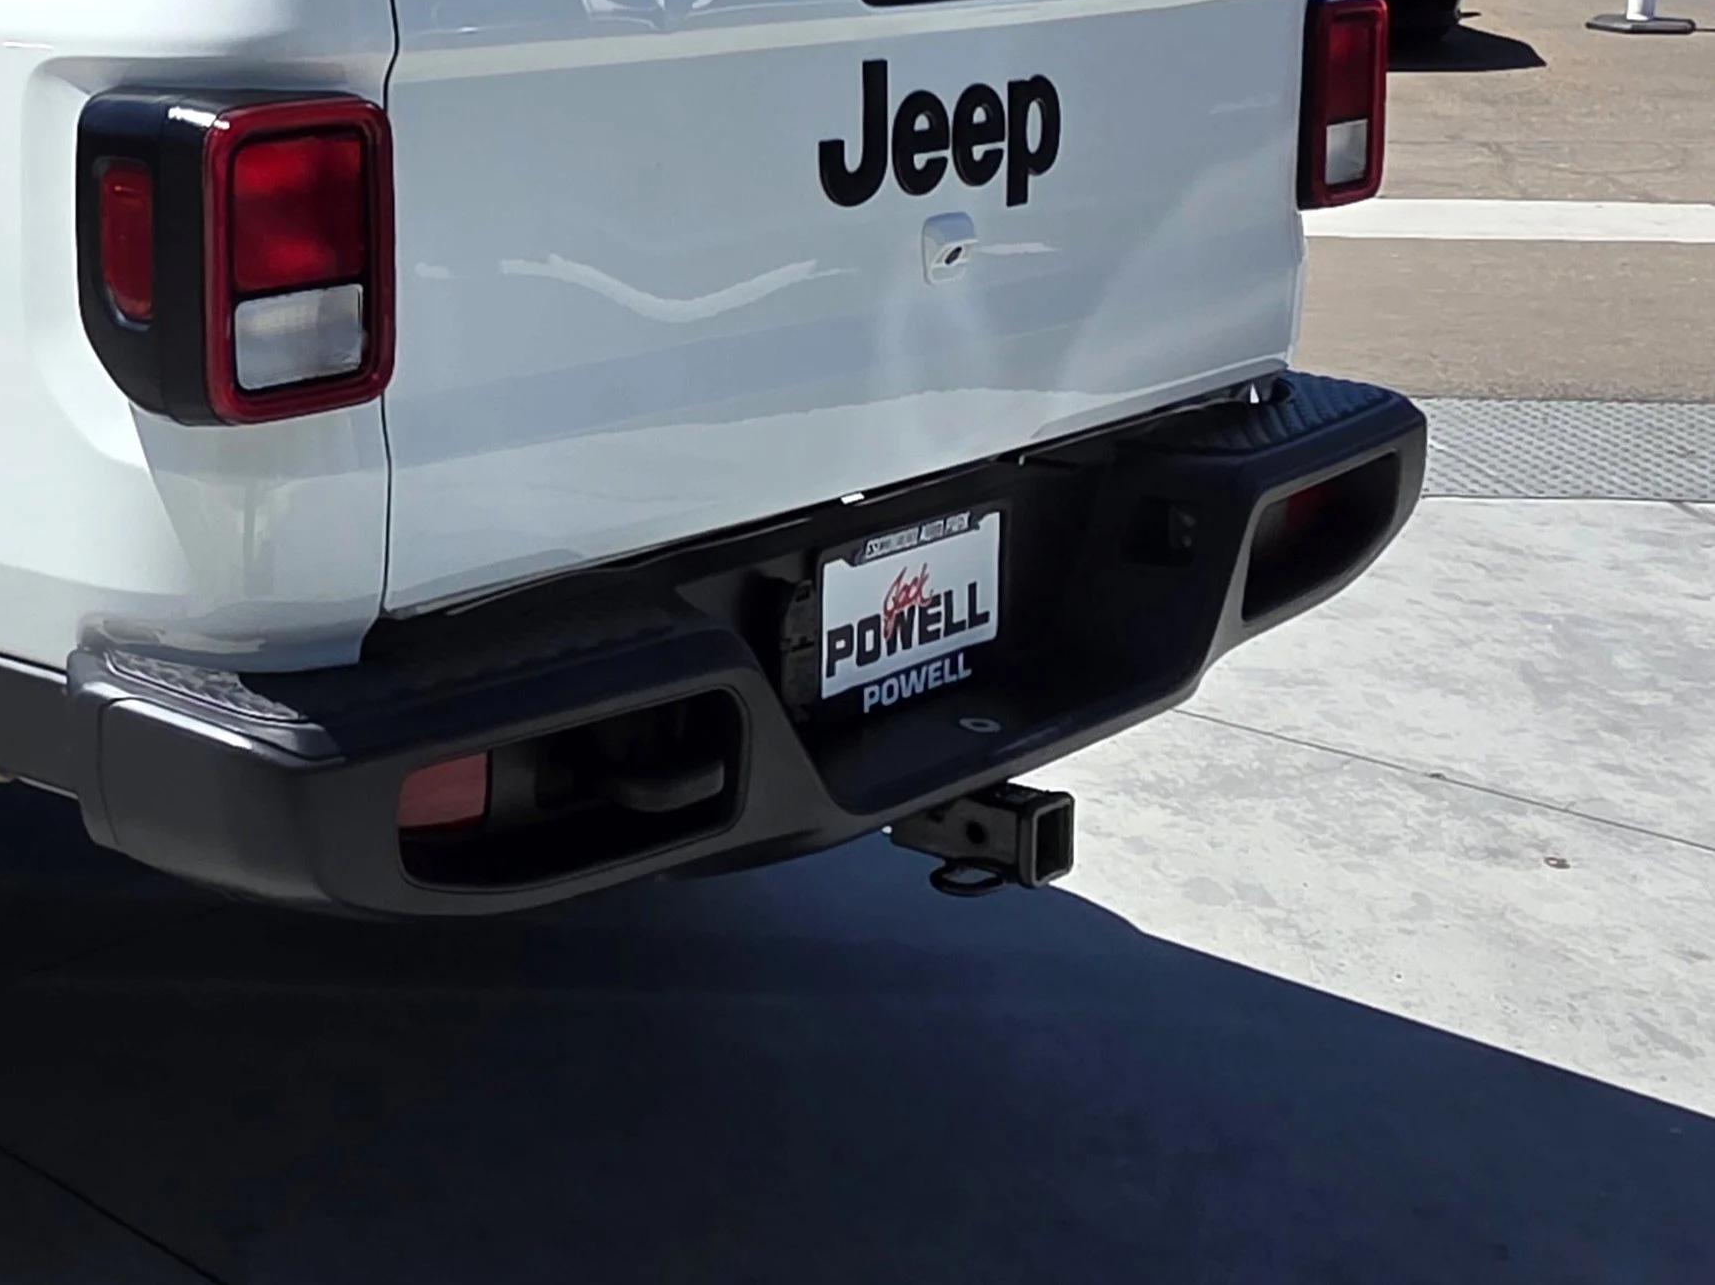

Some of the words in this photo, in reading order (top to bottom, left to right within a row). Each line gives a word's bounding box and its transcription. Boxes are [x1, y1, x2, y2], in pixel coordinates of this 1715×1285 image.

[818, 58, 1061, 207] Jeep
[825, 581, 990, 678] POWELL
[883, 563, 934, 641] Jack
[863, 652, 973, 714] POWELL
